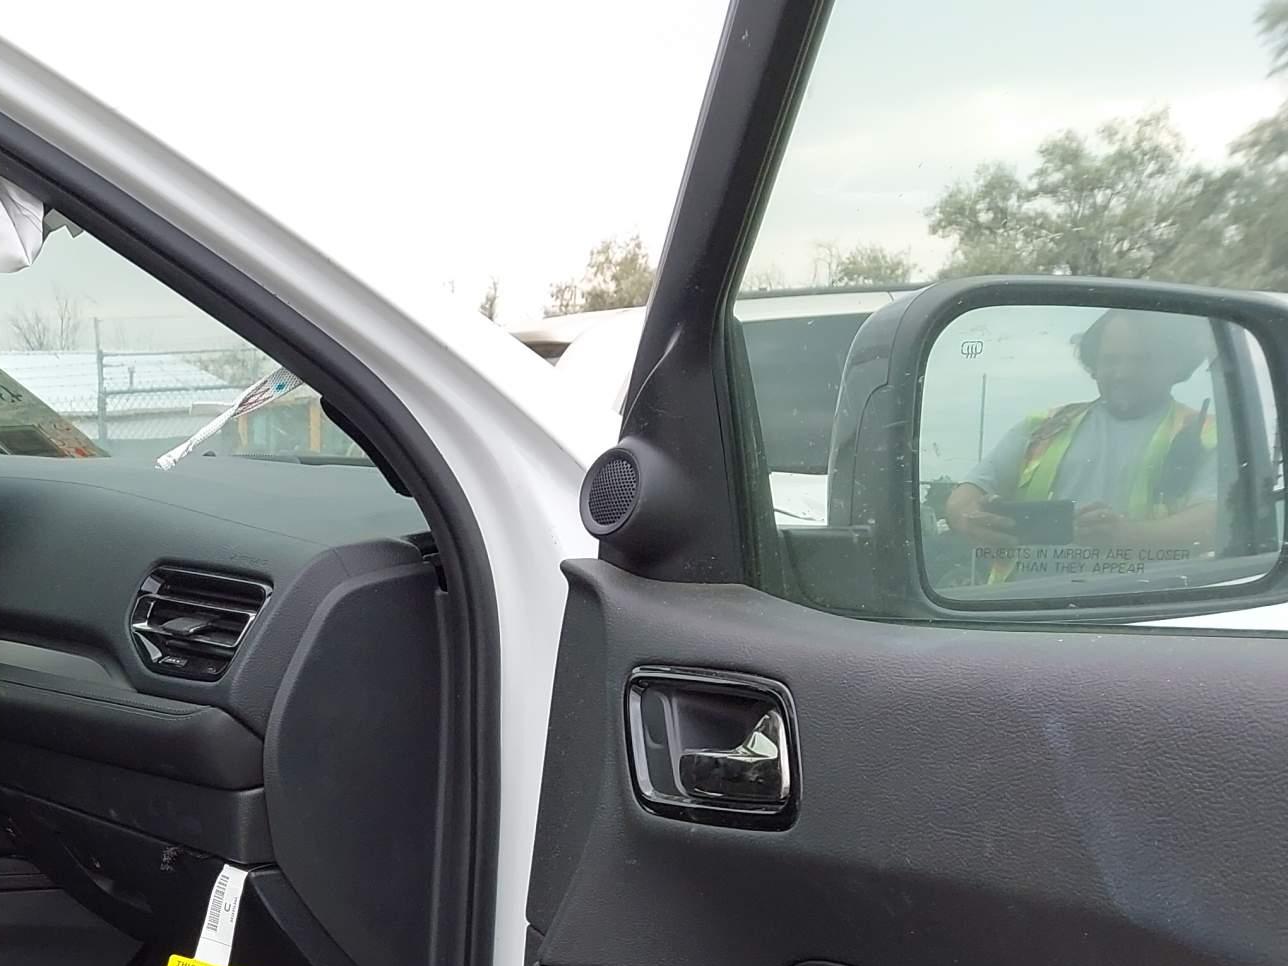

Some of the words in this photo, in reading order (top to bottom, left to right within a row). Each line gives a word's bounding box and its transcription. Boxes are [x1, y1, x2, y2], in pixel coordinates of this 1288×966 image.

[975, 547, 1031, 559] OBJECTS
[1037, 547, 1048, 559] IN
[1053, 547, 1100, 559] MIRROR
[1106, 547, 1133, 559] ARE
[1138, 547, 1190, 559] CLOSER
[1015, 562, 1048, 574] THAN
[1054, 562, 1087, 574] THEY
[1091, 562, 1145, 574] APPEAR
